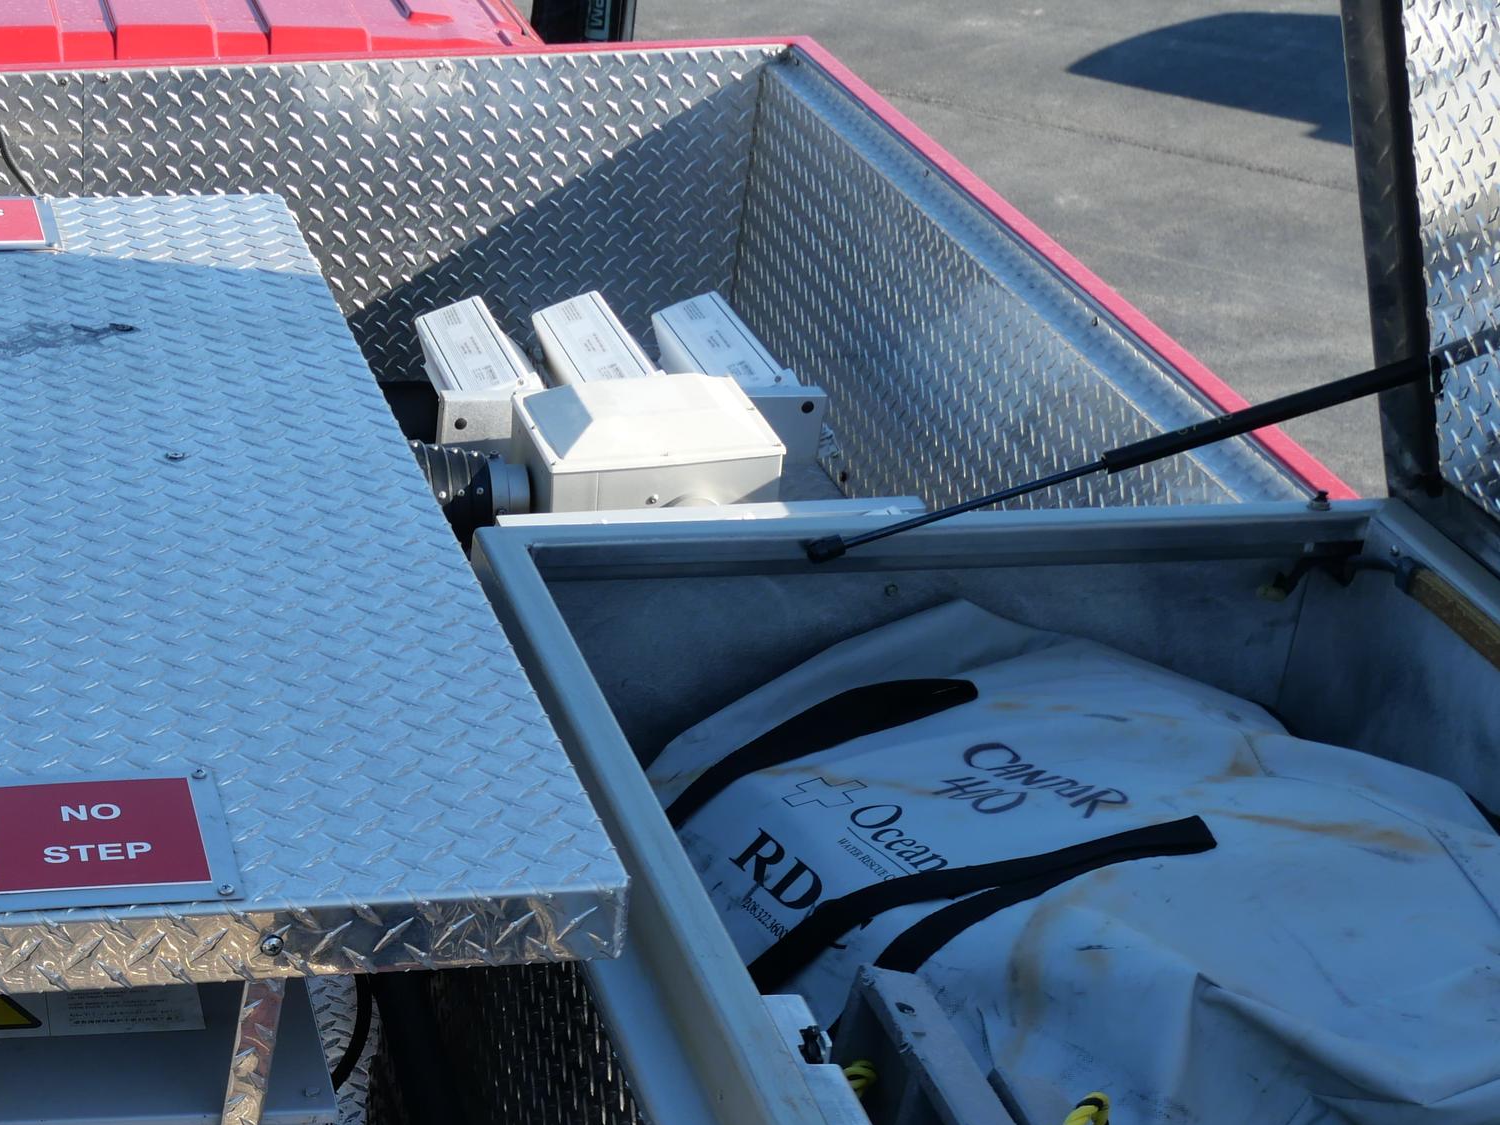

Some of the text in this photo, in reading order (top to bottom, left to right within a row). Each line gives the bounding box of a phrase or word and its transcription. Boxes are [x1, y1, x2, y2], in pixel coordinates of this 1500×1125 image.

[60, 803, 121, 822] NO
[43, 841, 152, 864] STEP
[837, 838, 889, 880] WATER RESCUE
